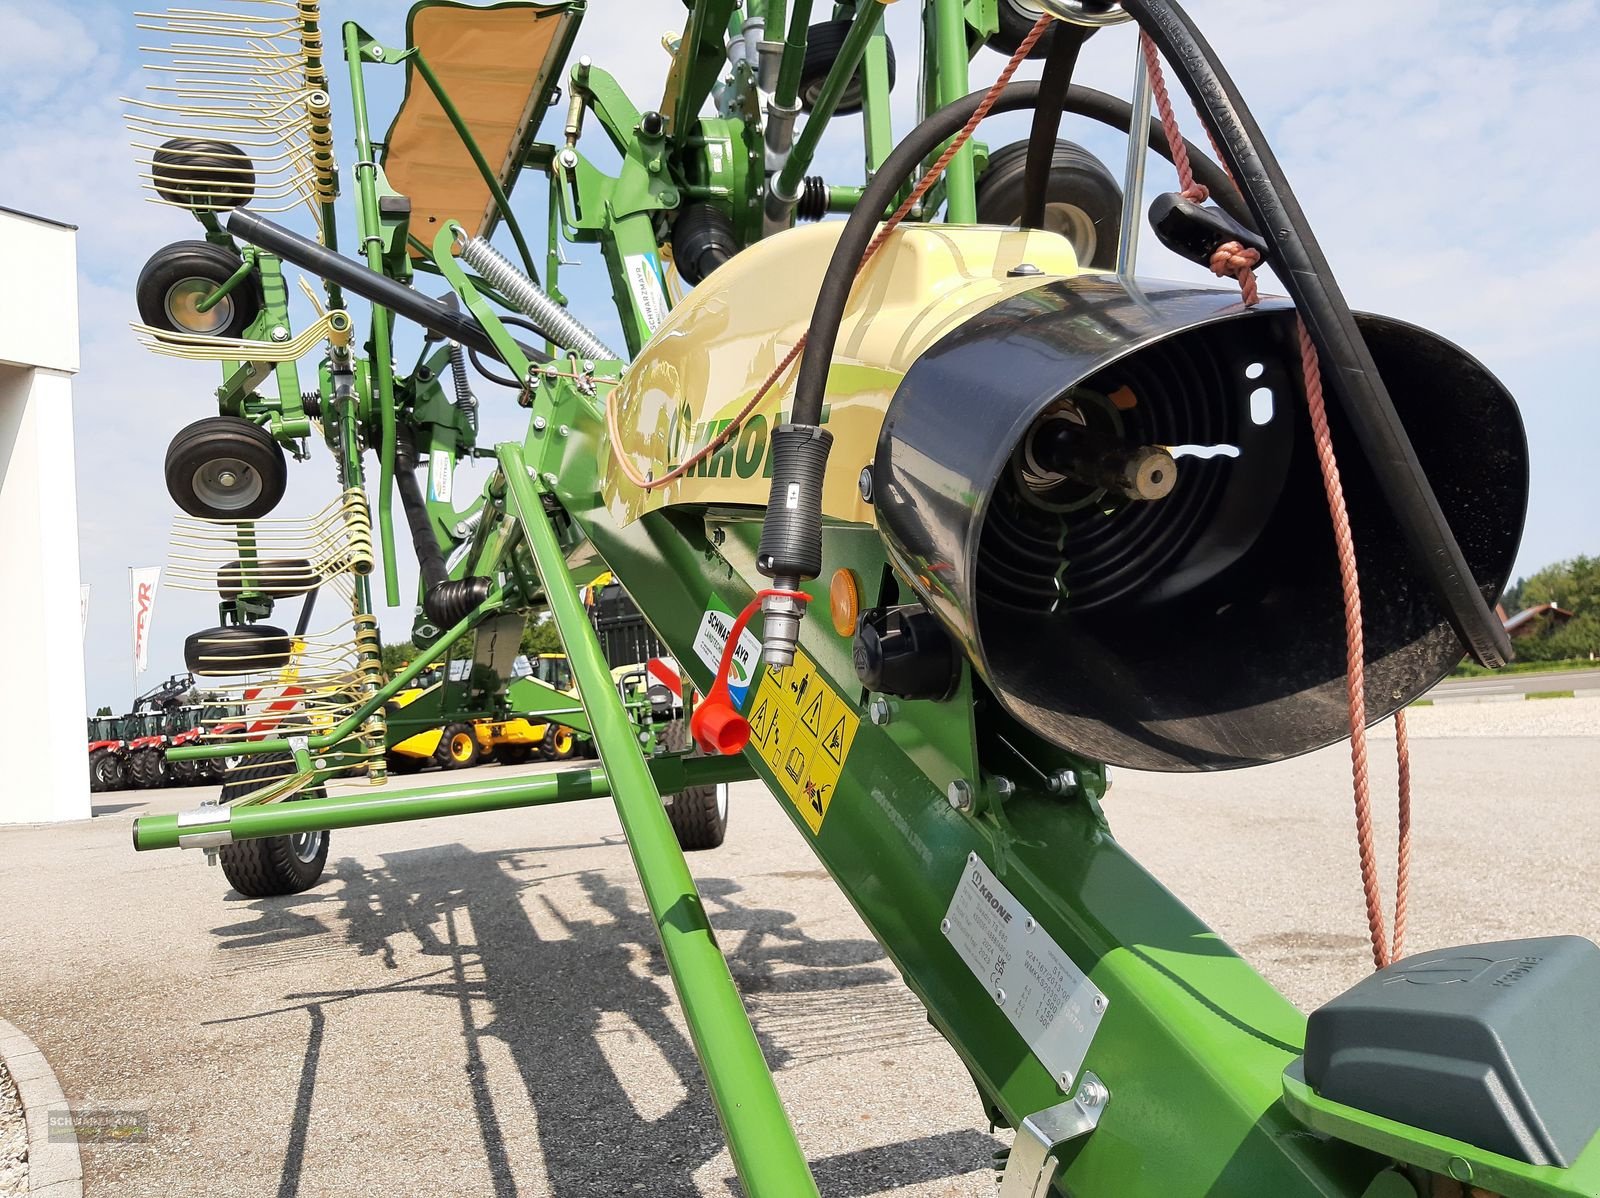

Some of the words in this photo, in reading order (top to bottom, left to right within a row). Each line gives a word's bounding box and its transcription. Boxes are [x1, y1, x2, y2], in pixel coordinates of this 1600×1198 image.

[635, 267, 657, 331] SCHWARZMAYR
[687, 404, 831, 478] KRO
[707, 612, 749, 666] SCHWARAYR
[978, 882, 1012, 926] KRONE
[978, 946, 991, 965] 2023
[981, 937, 994, 955] 2024
[993, 961, 1004, 976] CA
[996, 954, 1006, 969] UK
[1051, 965, 1064, 982] S1a
